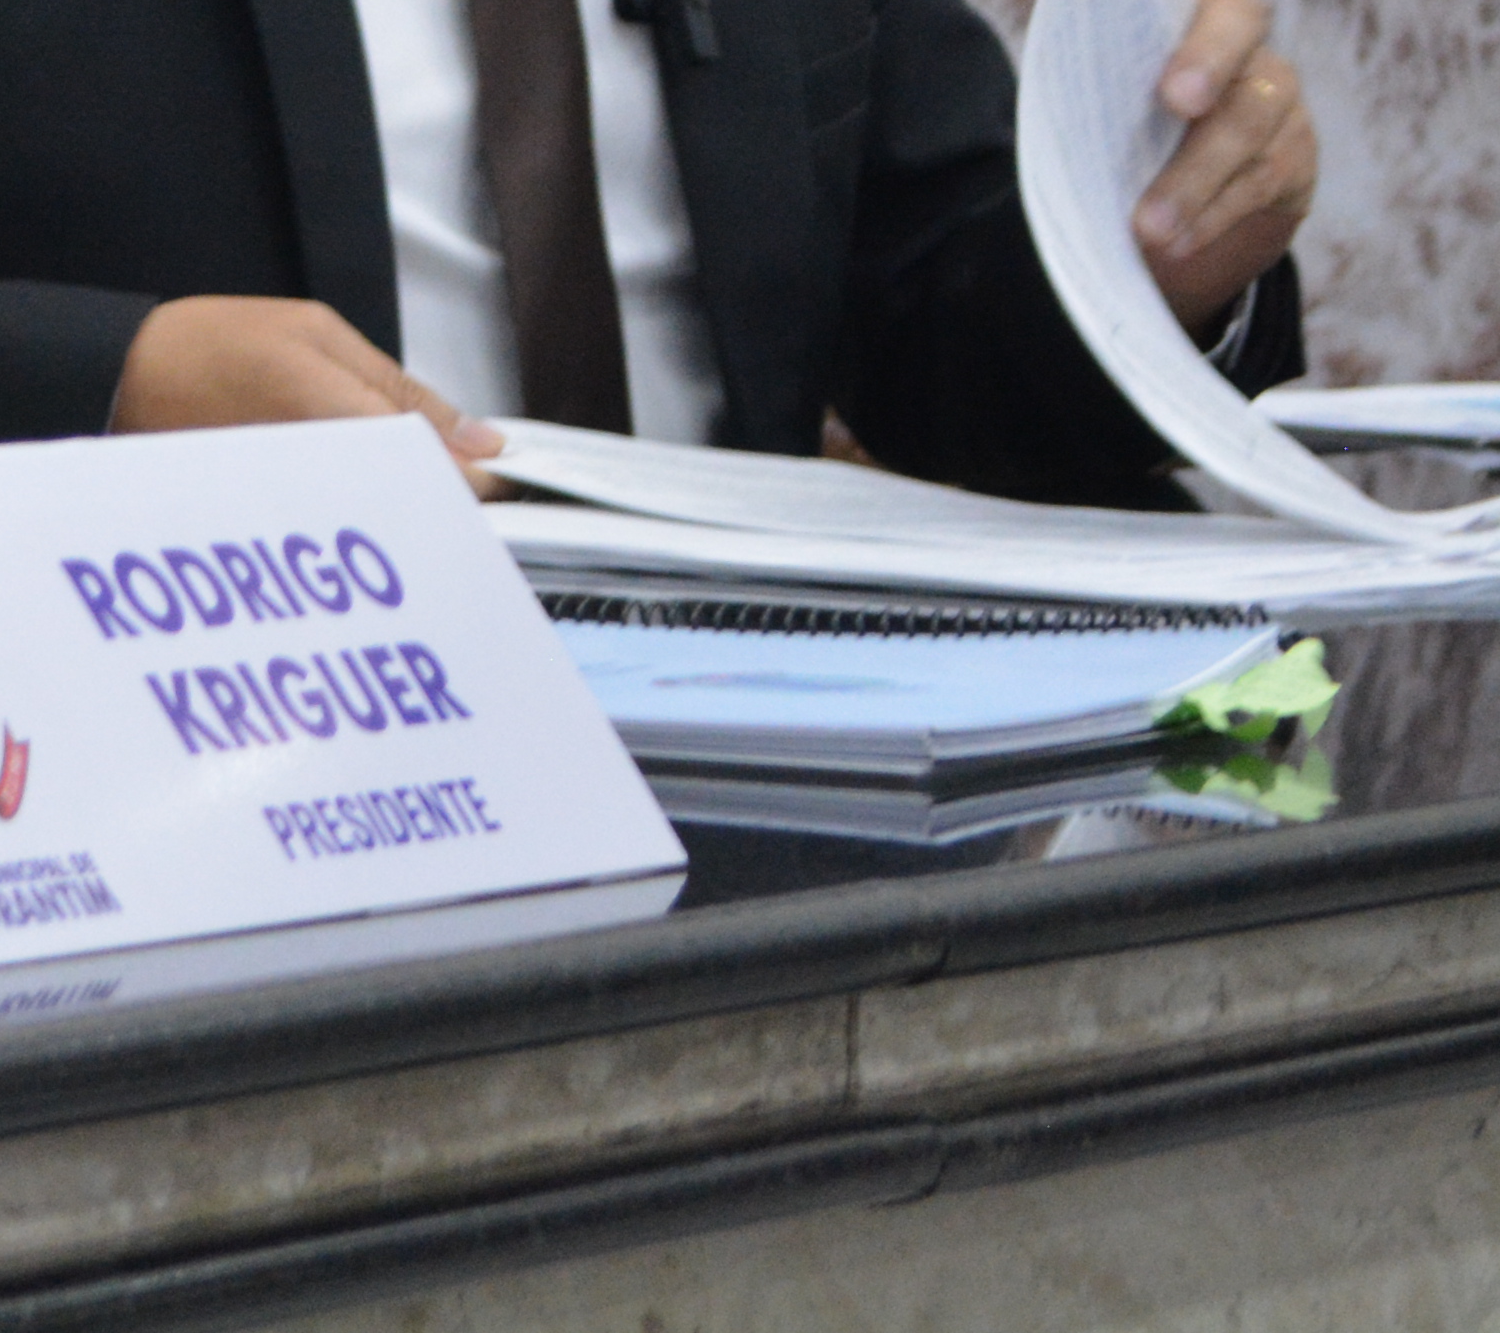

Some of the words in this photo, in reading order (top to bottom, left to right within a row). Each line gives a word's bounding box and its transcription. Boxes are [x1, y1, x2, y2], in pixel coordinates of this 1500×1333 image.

[60, 526, 405, 640] RODRIGO
[144, 641, 474, 755] KRIGUER
[69, 851, 99, 875] DE
[263, 777, 501, 862] PRESIDENTE
